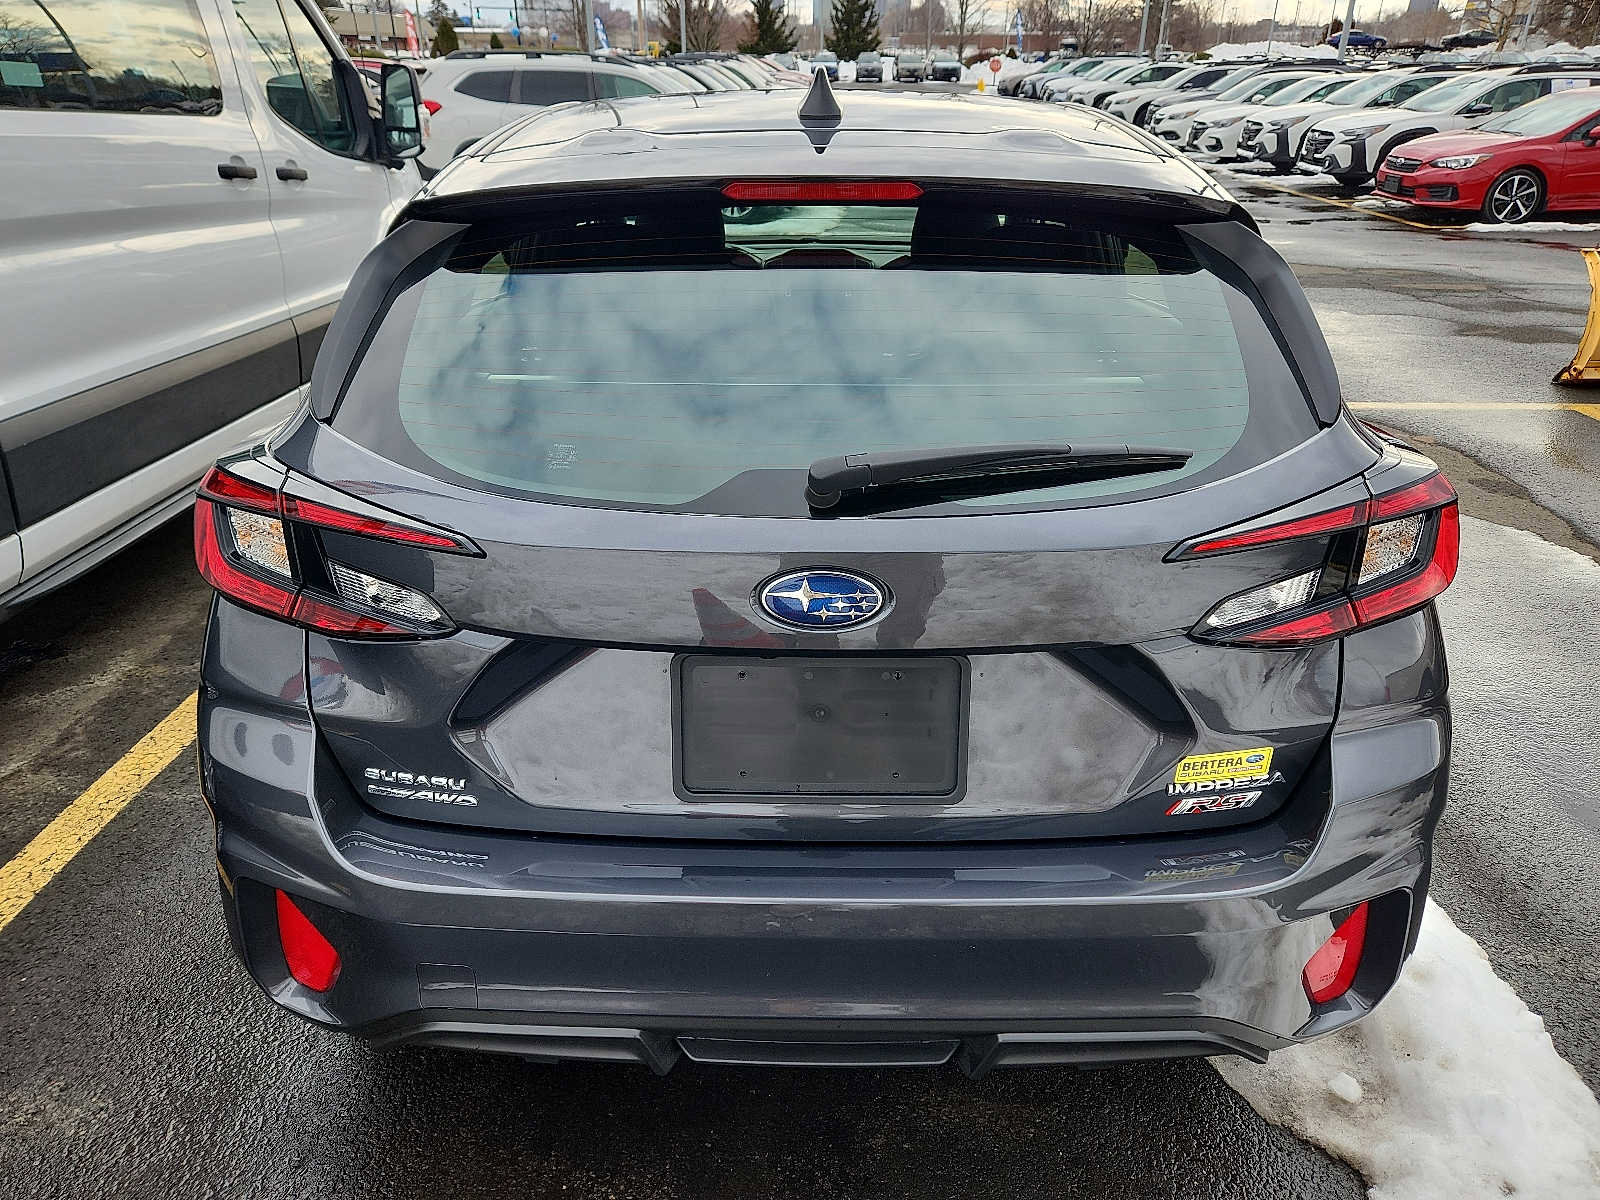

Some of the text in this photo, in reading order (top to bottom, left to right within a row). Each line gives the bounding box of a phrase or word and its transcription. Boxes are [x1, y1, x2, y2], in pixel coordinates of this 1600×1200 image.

[1182, 757, 1244, 772] BERTERA
[364, 767, 466, 791] SUBARU
[1180, 769, 1225, 778] SUBARU
[408, 789, 480, 807] AWD
